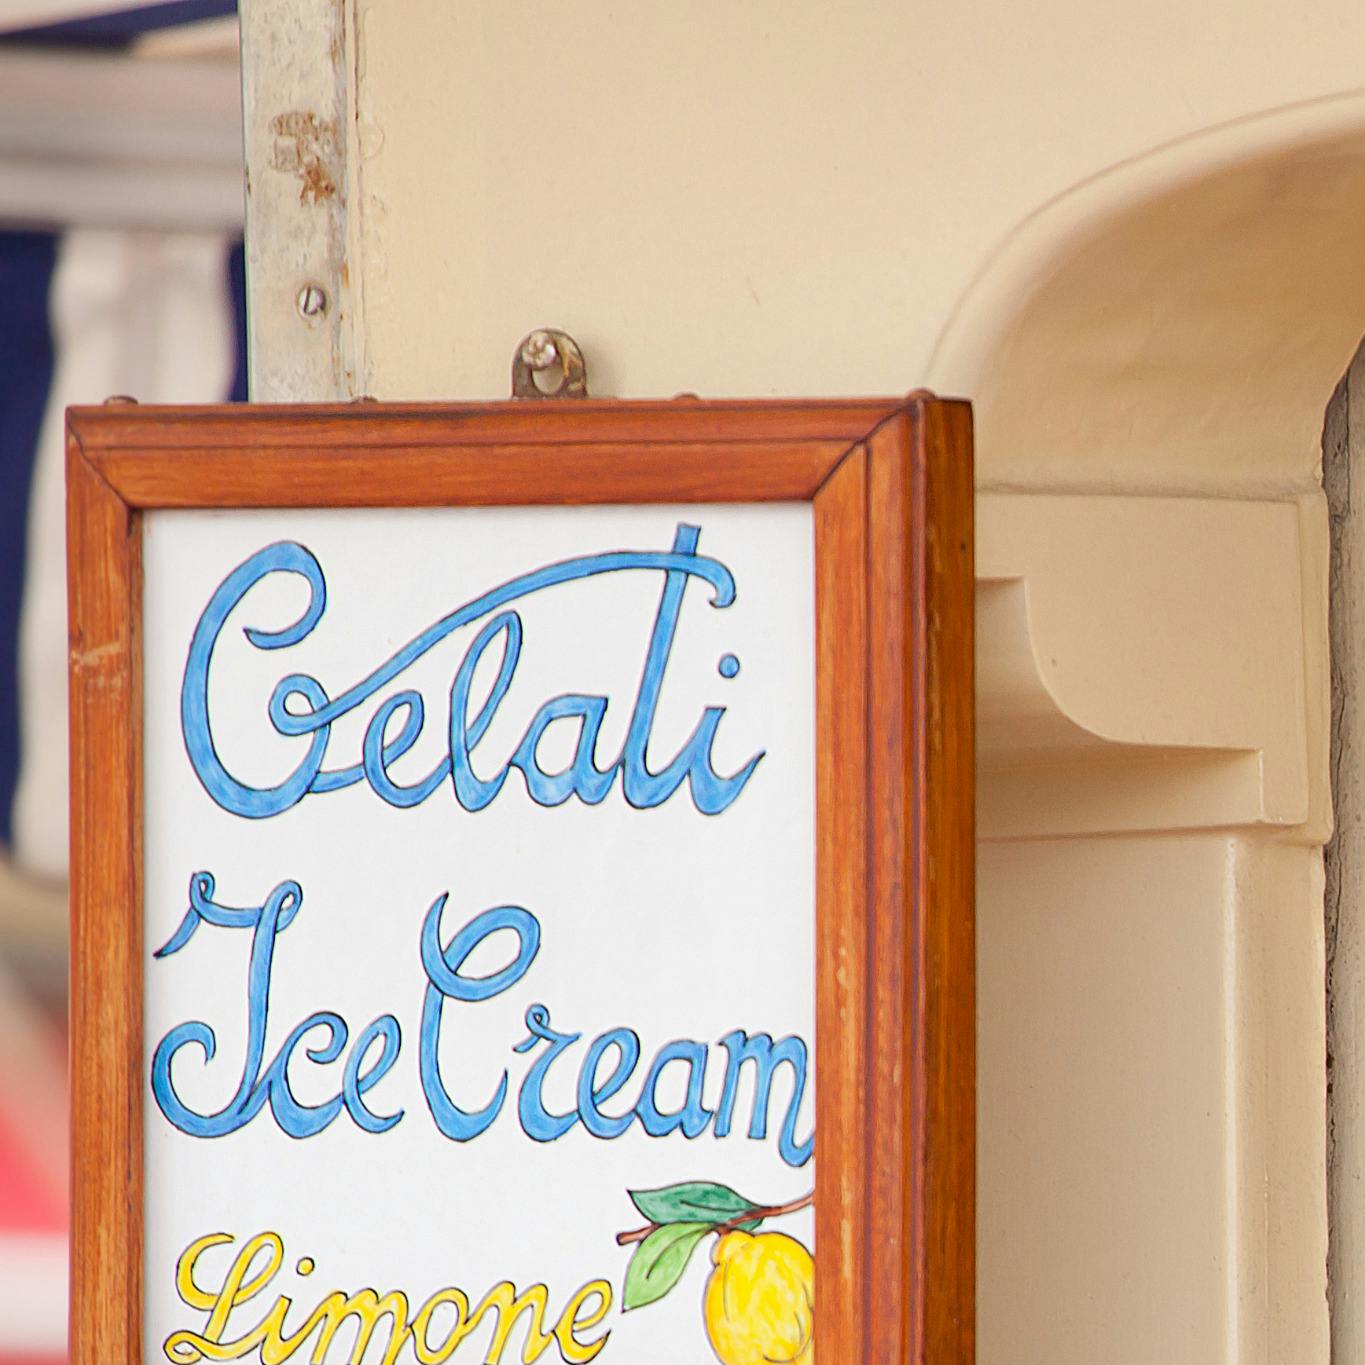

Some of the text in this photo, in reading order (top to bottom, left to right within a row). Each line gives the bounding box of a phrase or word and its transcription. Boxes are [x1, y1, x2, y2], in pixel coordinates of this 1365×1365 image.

[181, 522, 766, 819] Gelati
[152, 871, 815, 1168] Ice Cream
